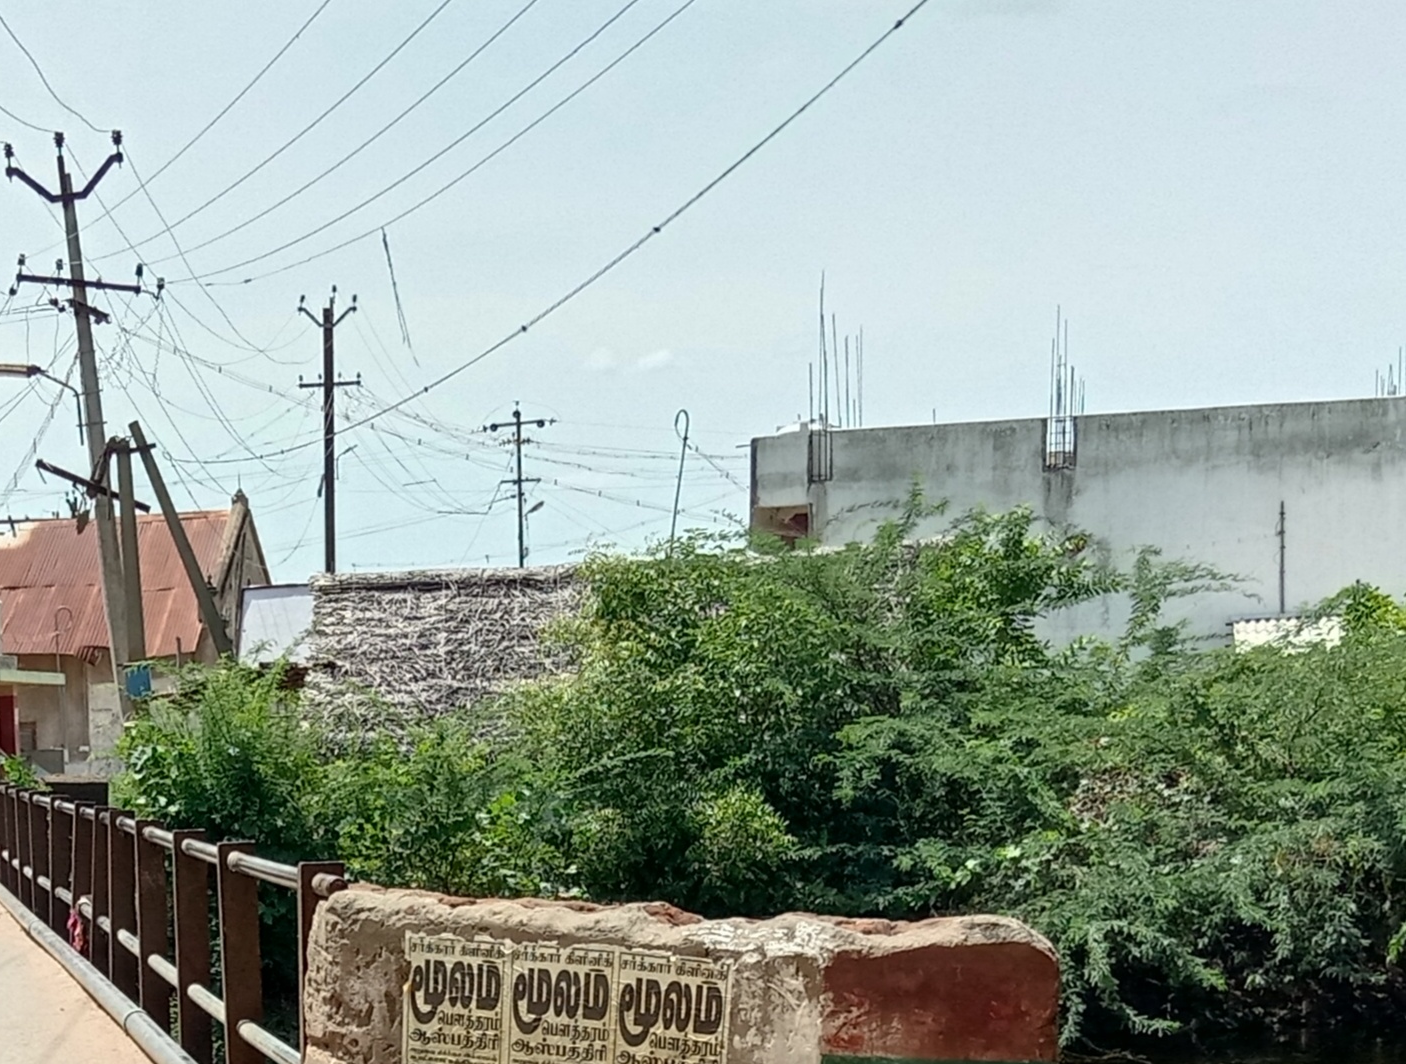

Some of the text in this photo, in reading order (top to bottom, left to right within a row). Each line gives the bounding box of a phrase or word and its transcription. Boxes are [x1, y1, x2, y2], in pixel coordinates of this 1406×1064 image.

[411, 959, 501, 1025] மூலம்
[513, 969, 609, 1035] மூலம்
[619, 977, 723, 1047] மூலம்
[409, 1024, 499, 1050] ஆஸ்பத்திரி
[511, 1037, 607, 1062] ஆஸ்பத்திரி
